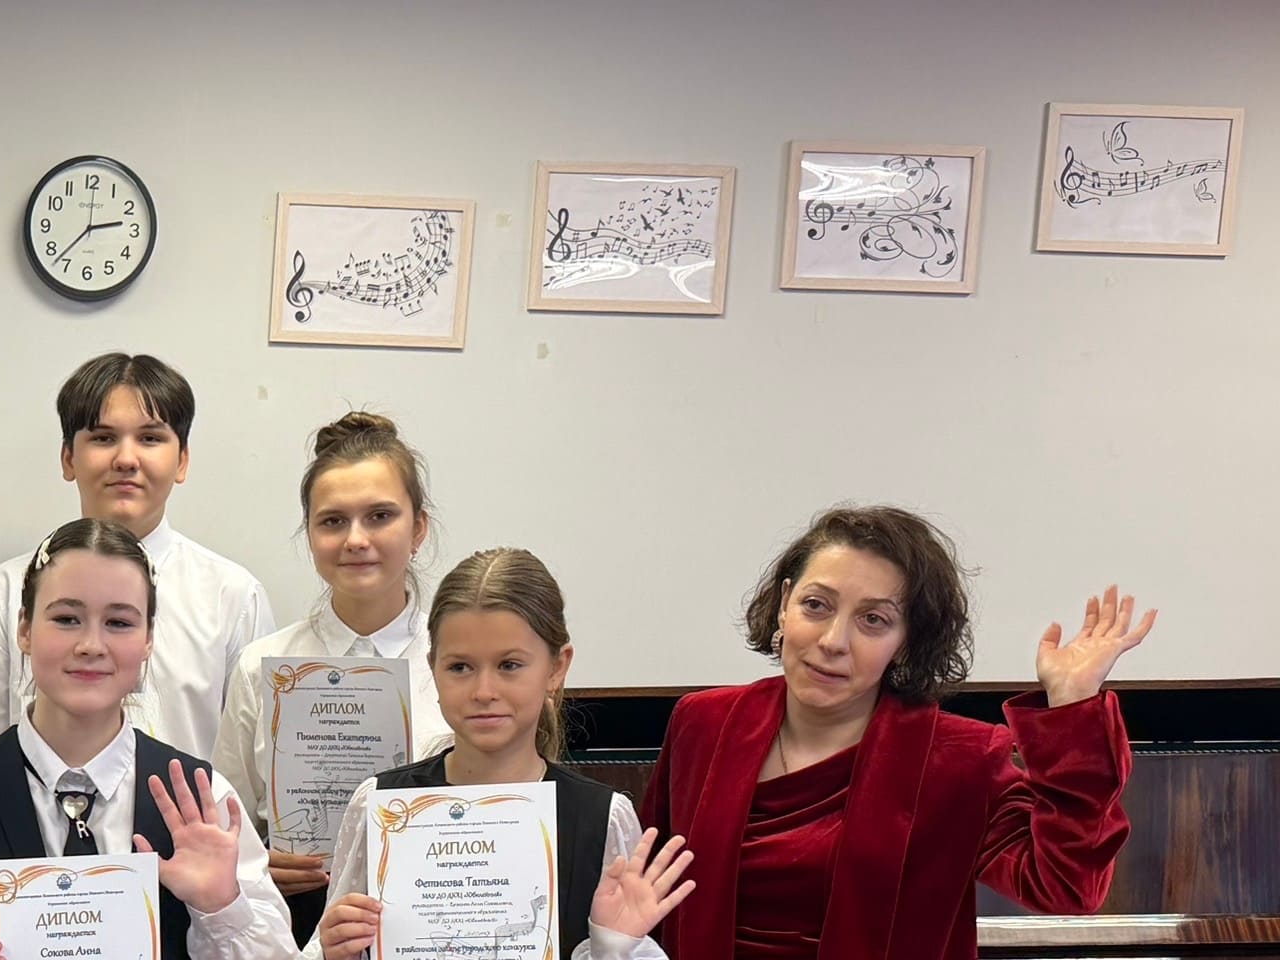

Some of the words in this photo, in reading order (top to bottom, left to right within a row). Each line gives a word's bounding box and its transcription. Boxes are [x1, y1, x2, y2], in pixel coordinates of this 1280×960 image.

[65, 181, 73, 197] 11
[85, 174, 100, 190] 12
[111, 183, 116, 199] 1
[48, 195, 63, 211] 10
[123, 200, 135, 215] 2
[40, 218, 51, 233] 9
[129, 223, 140, 238] 3
[46, 241, 57, 256] 8
[120, 245, 131, 260] 4
[61, 258, 72, 273] 7
[104, 260, 114, 275] 5
[82, 266, 93, 281] 6
[310, 703, 365, 717] ДИПЛОМ
[297, 732, 336, 742] Пименова
[338, 732, 382, 744] Екатерина
[76, 820, 89, 839] R
[426, 840, 496, 859] ДИПЛОМ
[437, 860, 488, 870] награждается
[415, 878, 464, 888] Фетисова
[465, 876, 510, 886] Татьяна
[36, 910, 103, 930] ДИПЛОМ
[47, 930, 96, 939] награждается
[40, 947, 74, 958] Сокова
[76, 946, 102, 957] Анна
[401, 944, 437, 955] районном
[503, 944, 536, 954] конкурса
